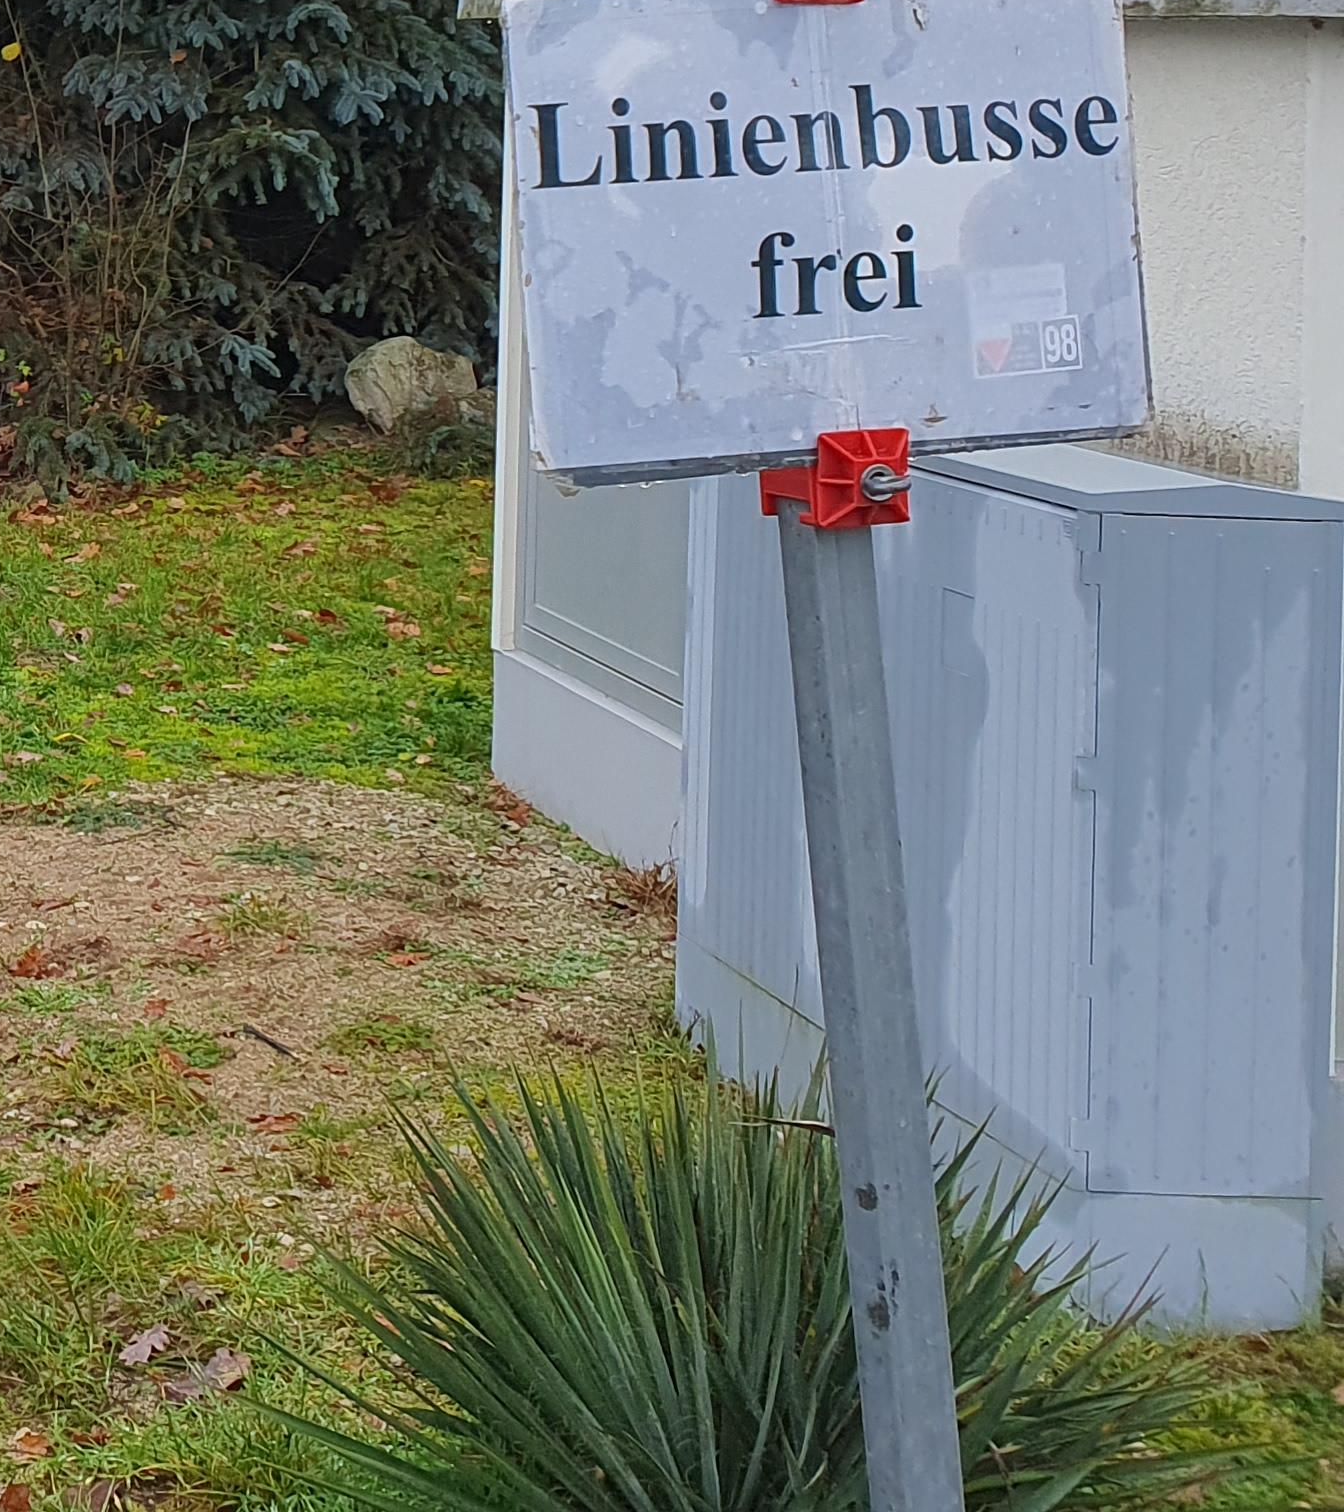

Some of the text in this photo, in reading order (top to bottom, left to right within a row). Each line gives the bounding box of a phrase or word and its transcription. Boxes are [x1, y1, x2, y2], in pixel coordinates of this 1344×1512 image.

[527, 84, 1120, 190] Linienbusse
[750, 224, 924, 320] frei
[1044, 323, 1078, 363] 98
